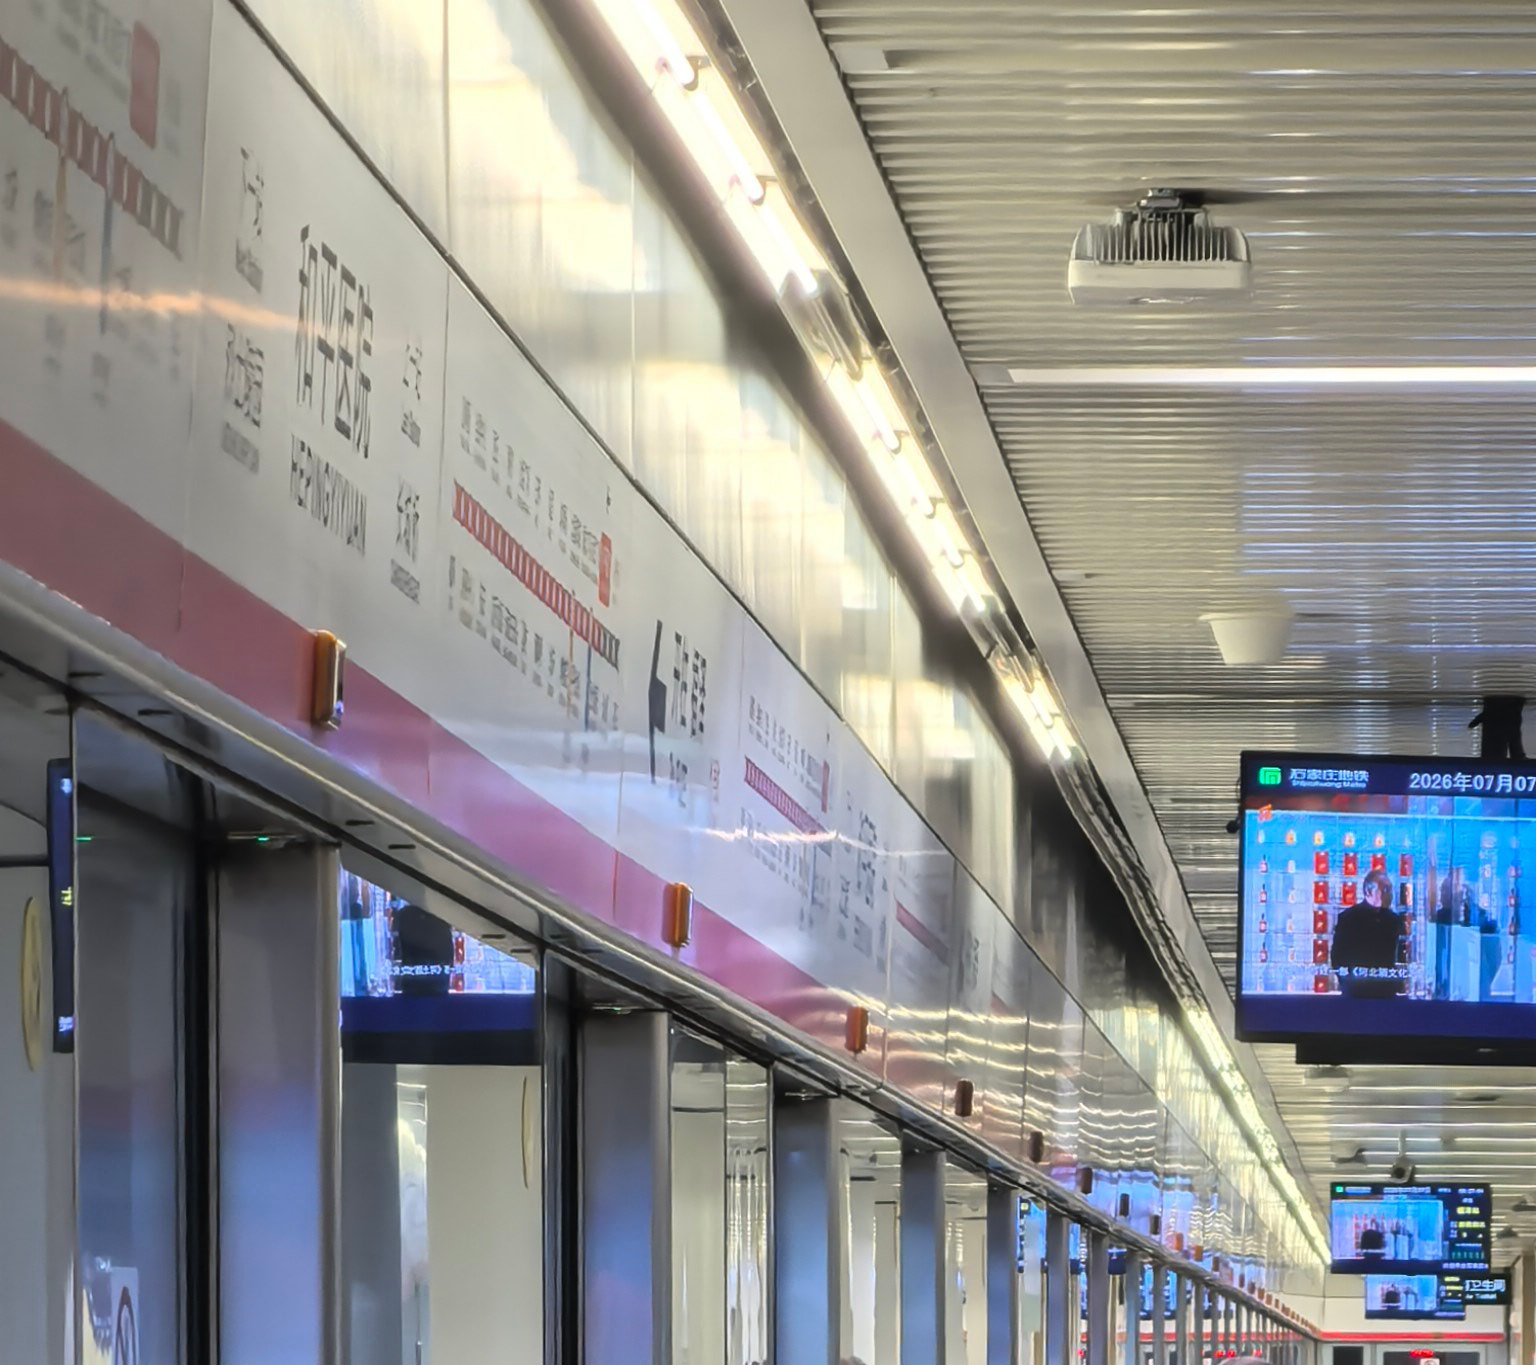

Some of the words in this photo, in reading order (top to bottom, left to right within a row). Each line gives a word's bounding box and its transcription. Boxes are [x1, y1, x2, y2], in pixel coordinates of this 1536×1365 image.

[297, 224, 374, 459] 和平医院
[1289, 768, 1370, 782] 石家庄地铁
